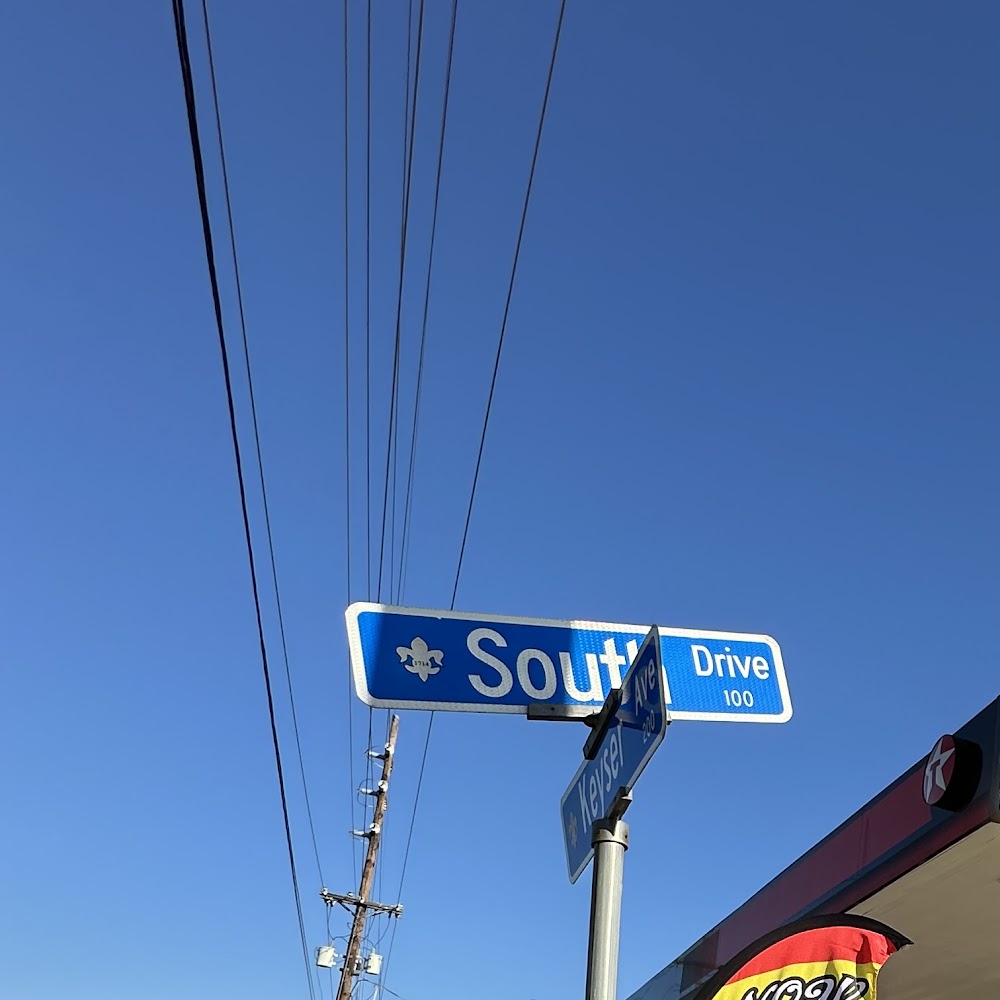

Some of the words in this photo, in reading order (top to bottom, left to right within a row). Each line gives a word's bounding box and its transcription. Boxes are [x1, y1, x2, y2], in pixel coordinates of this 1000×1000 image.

[691, 644, 770, 681] Drive
[635, 658, 655, 715] Ave
[723, 689, 754, 708] 100
[577, 719, 623, 834] Keyser
